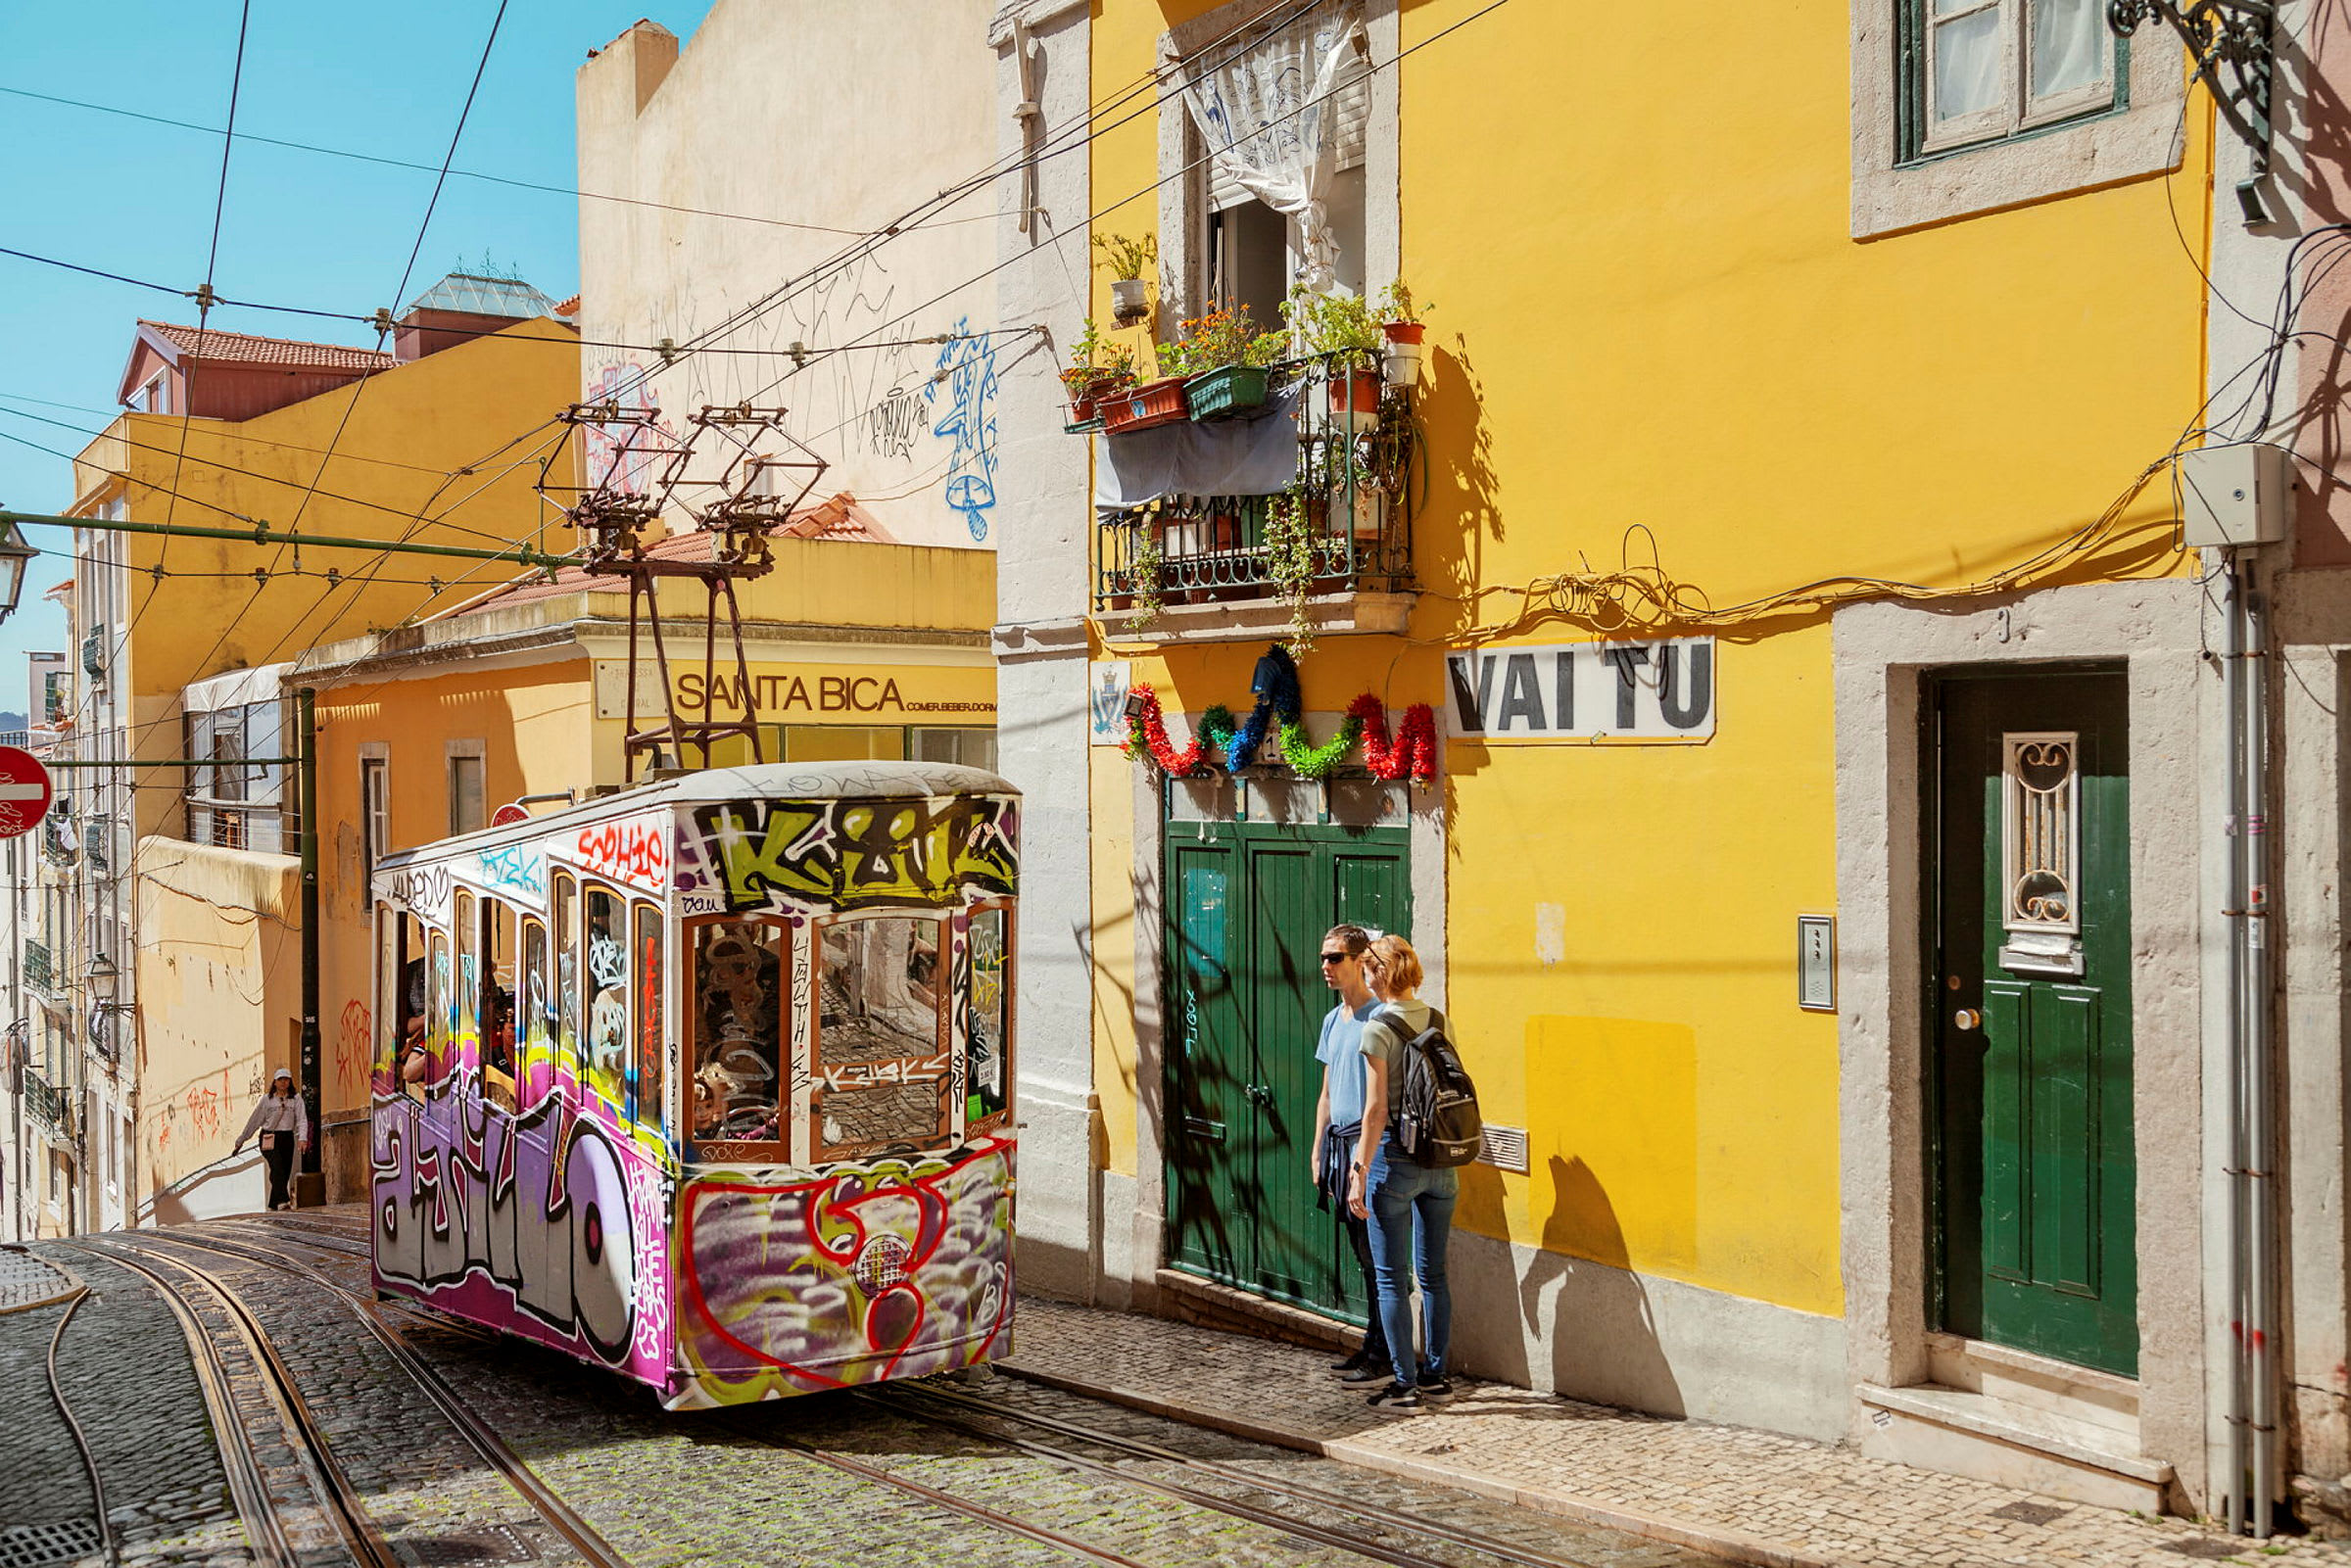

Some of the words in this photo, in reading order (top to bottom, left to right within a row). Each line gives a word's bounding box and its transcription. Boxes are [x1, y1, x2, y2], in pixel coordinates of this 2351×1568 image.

[676, 673, 812, 711] SANTA
[819, 676, 905, 712] BICA
[1447, 651, 1574, 732] VAI
[1604, 643, 1711, 730] TU
[1265, 736, 1276, 758] 1
